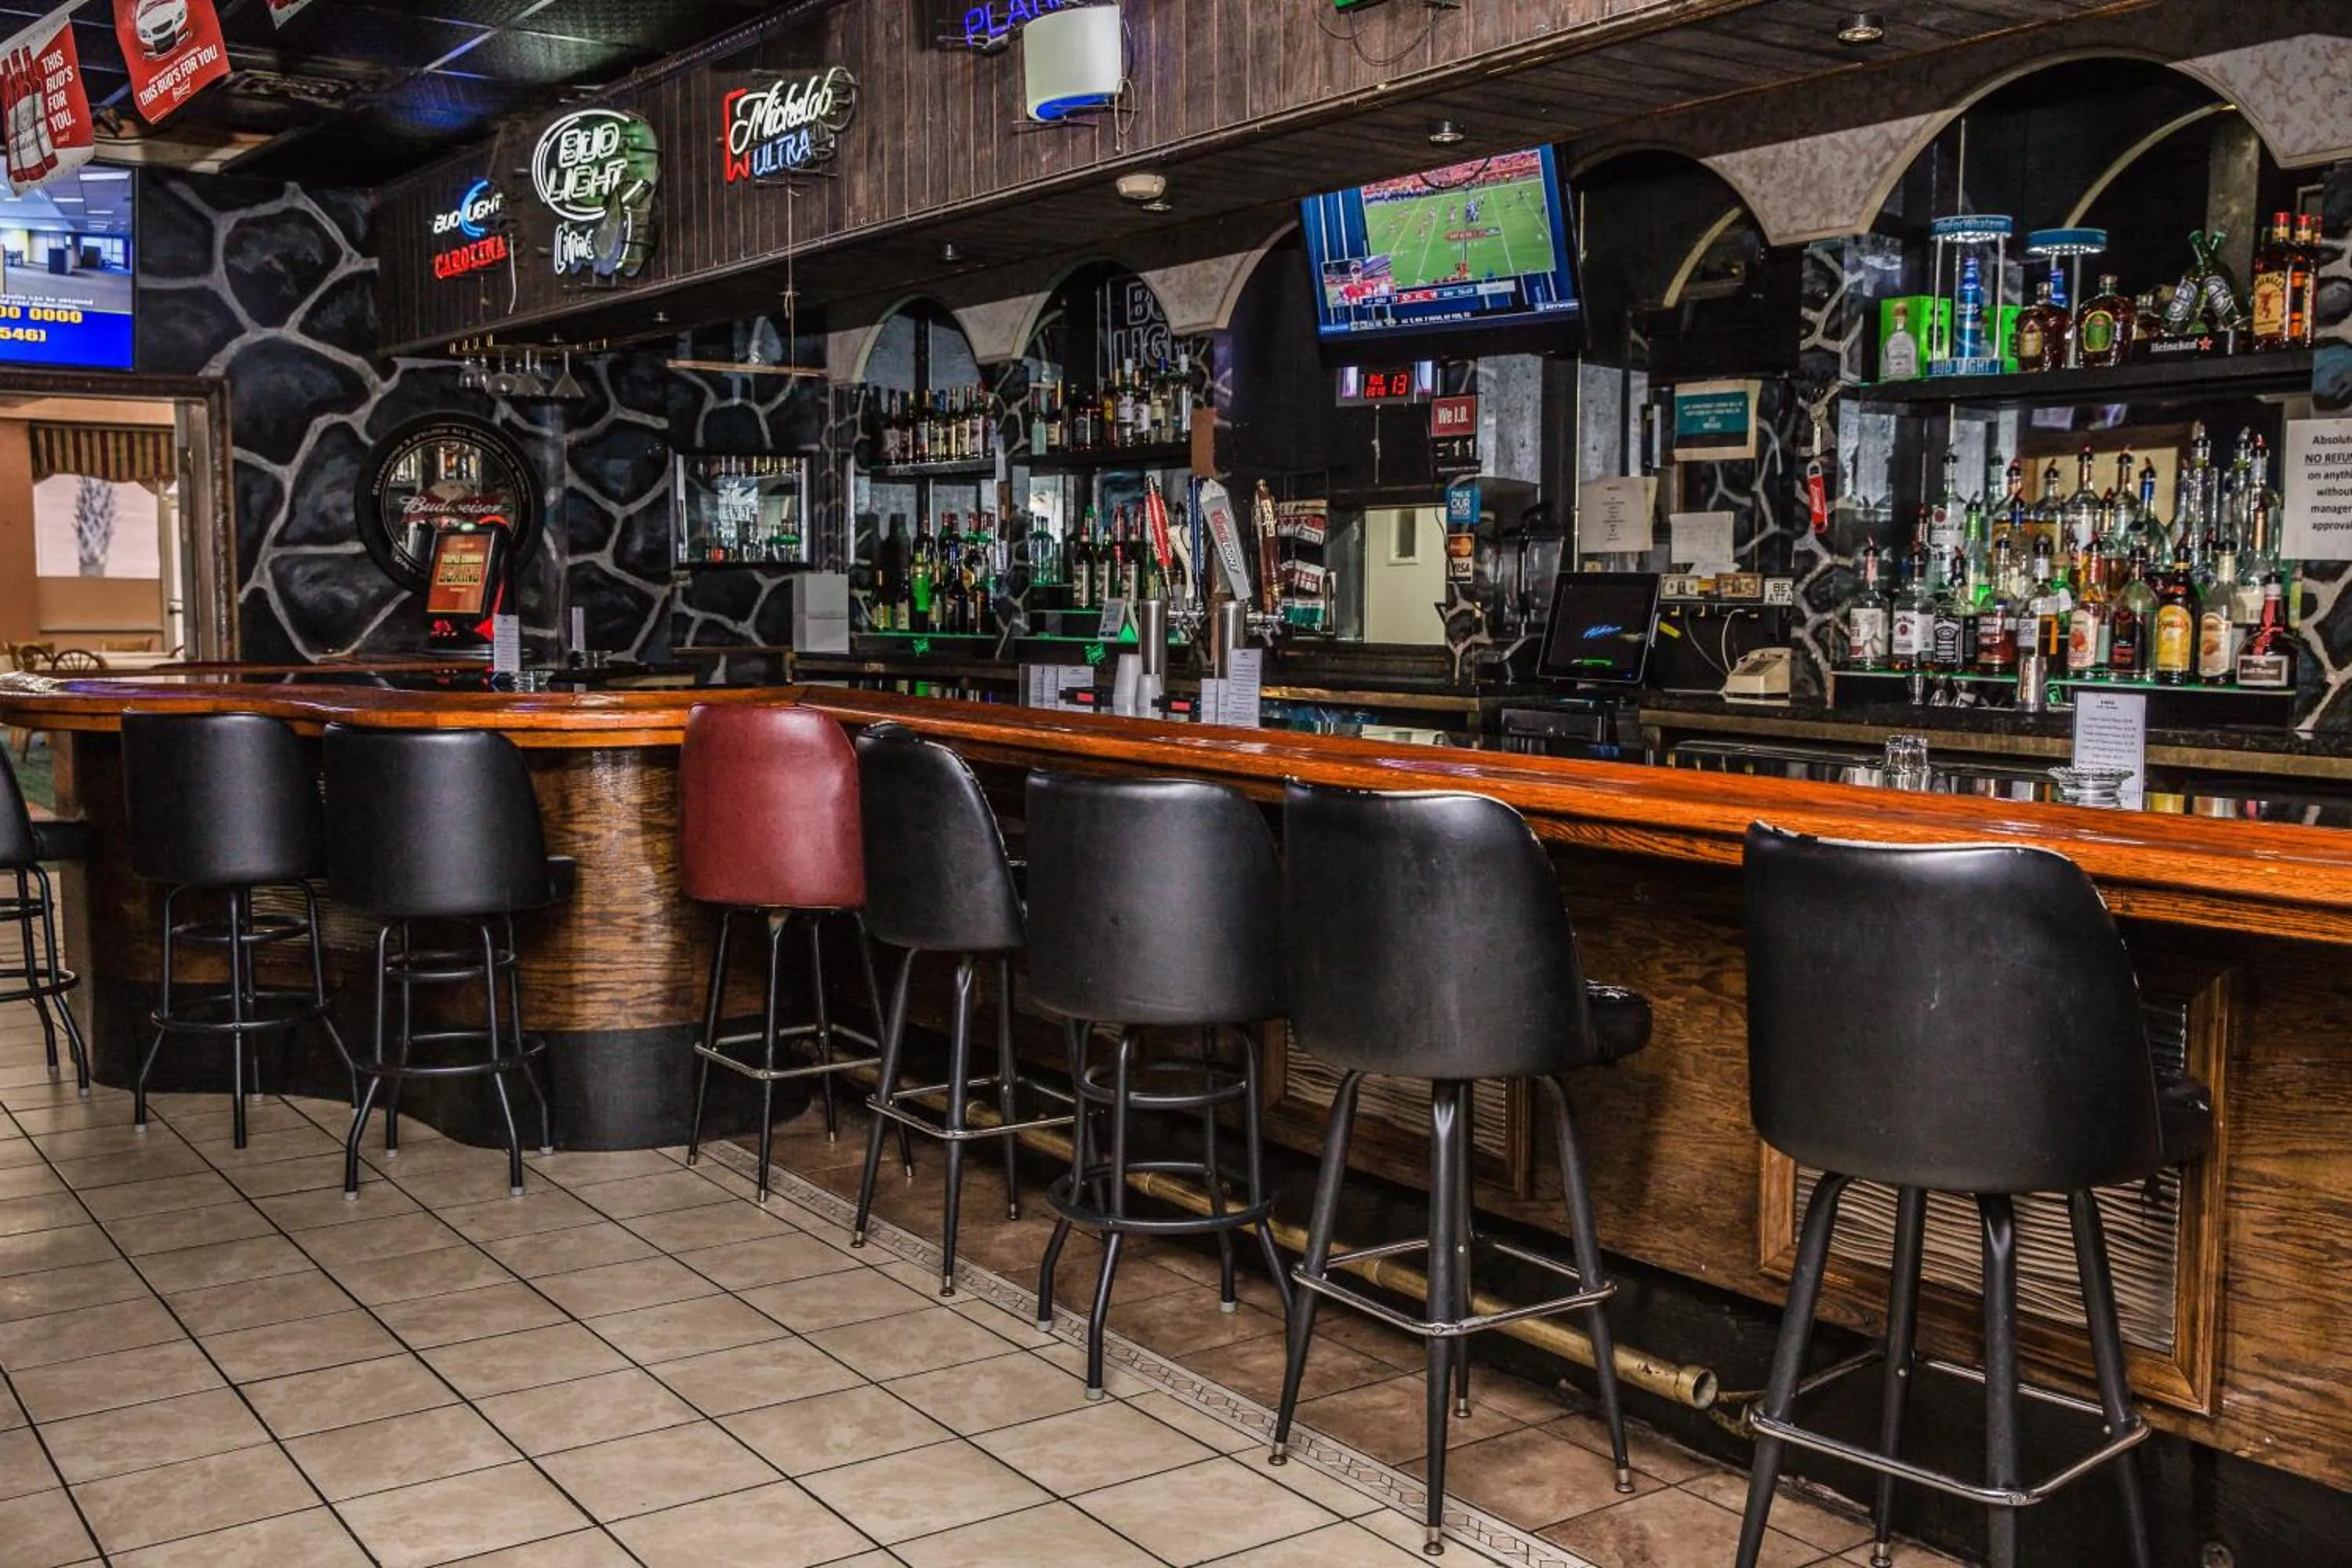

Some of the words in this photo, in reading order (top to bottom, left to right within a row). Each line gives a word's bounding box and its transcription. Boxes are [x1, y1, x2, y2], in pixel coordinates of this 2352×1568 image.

[42, 49, 64, 74] THIS
[46, 66, 74, 93] BUD'S
[140, 84, 158, 106] THIS
[157, 67, 181, 93] BUD'S
[180, 57, 198, 78] FOR
[48, 90, 68, 113] FOR
[729, 67, 837, 155] Michelob
[49, 110, 76, 132] YOU.
[558, 122, 620, 168] BUD
[753, 128, 811, 176] ULTRA
[548, 158, 628, 202] LIGHT
[434, 209, 460, 234] BUD
[467, 192, 504, 222] LIGHT
[435, 235, 508, 279] CAROLINA
[29, 307, 83, 324] 0000
[2151, 339, 2197, 354] Heineken
[1438, 407, 1452, 424] We
[2312, 434, 2352, 445] Absolut
[2305, 453, 2322, 464] NO
[2317, 487, 2352, 497] without
[2310, 506, 2352, 514] manager
[2311, 521, 2352, 532] approval
